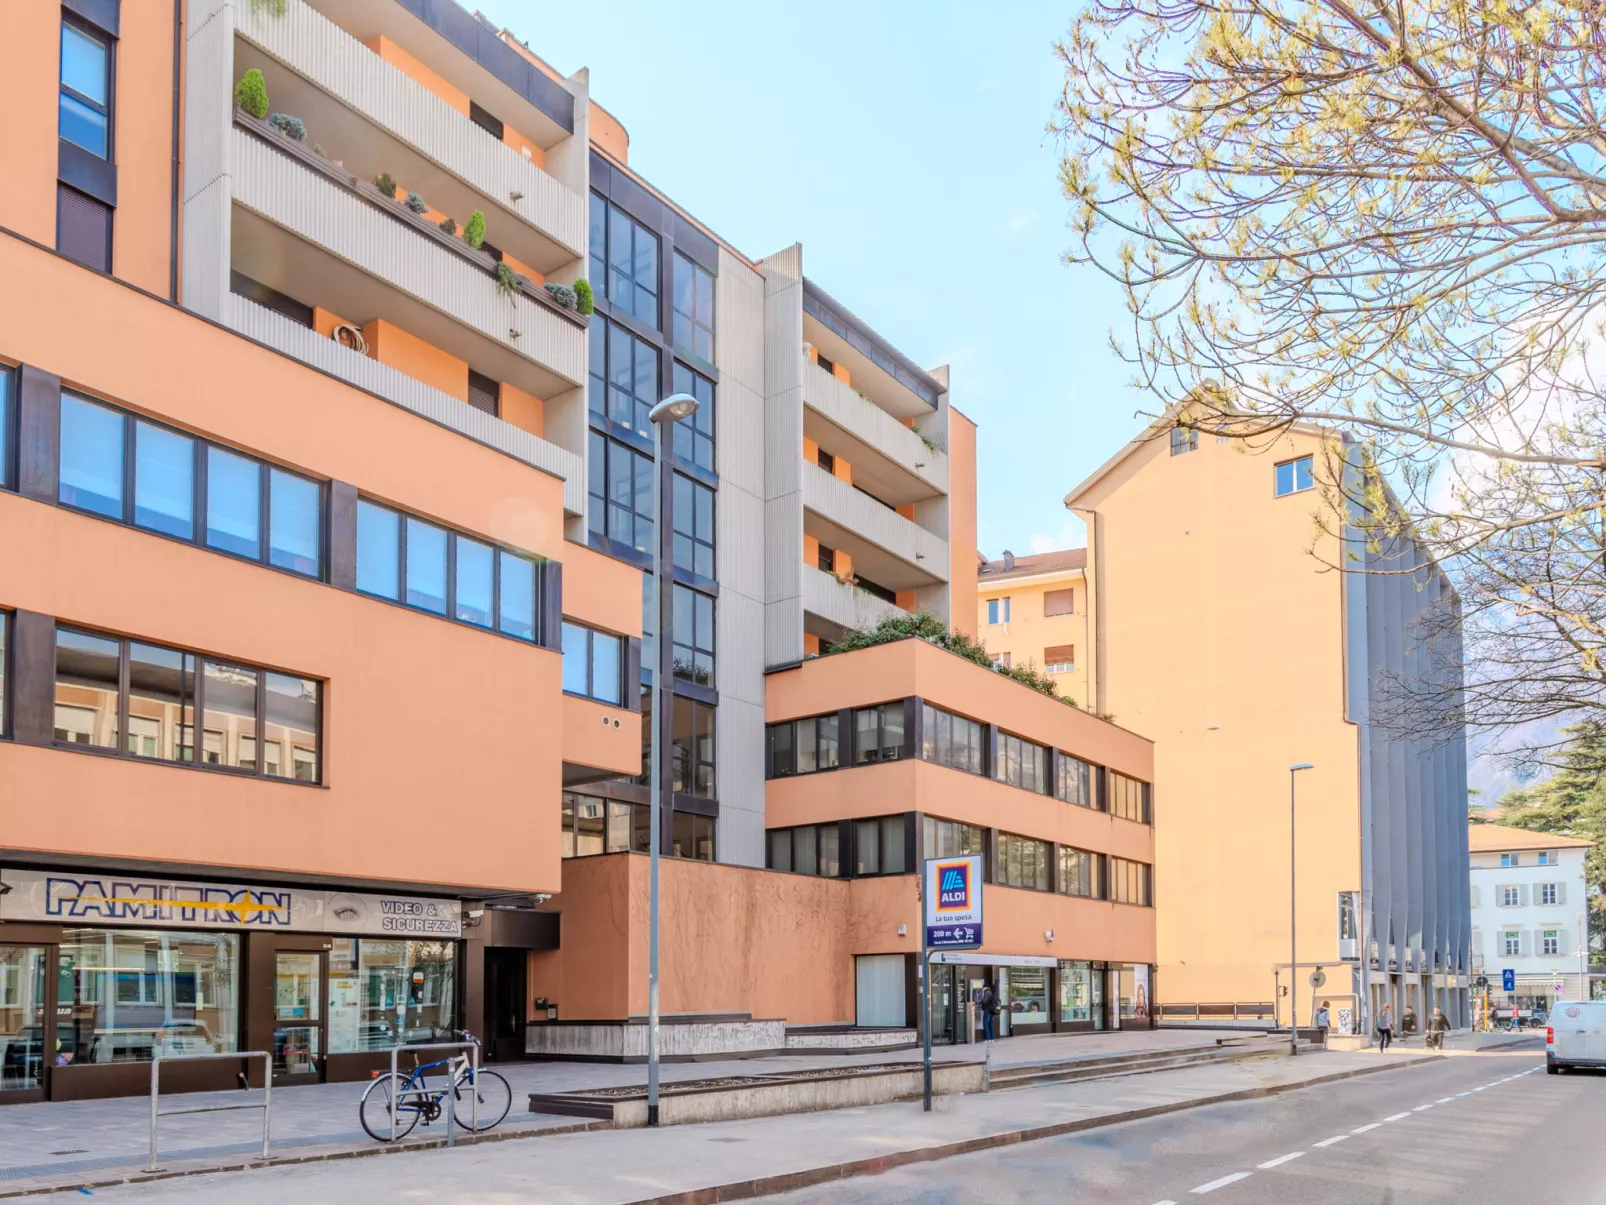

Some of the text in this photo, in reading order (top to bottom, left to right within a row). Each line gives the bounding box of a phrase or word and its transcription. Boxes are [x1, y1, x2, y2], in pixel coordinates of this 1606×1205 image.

[46, 878, 291, 925] PAMITRON
[941, 891, 965, 902] ALDI
[380, 900, 438, 916] VIDEO &
[382, 916, 459, 933] SICUREZZA
[933, 930, 944, 938] 200
